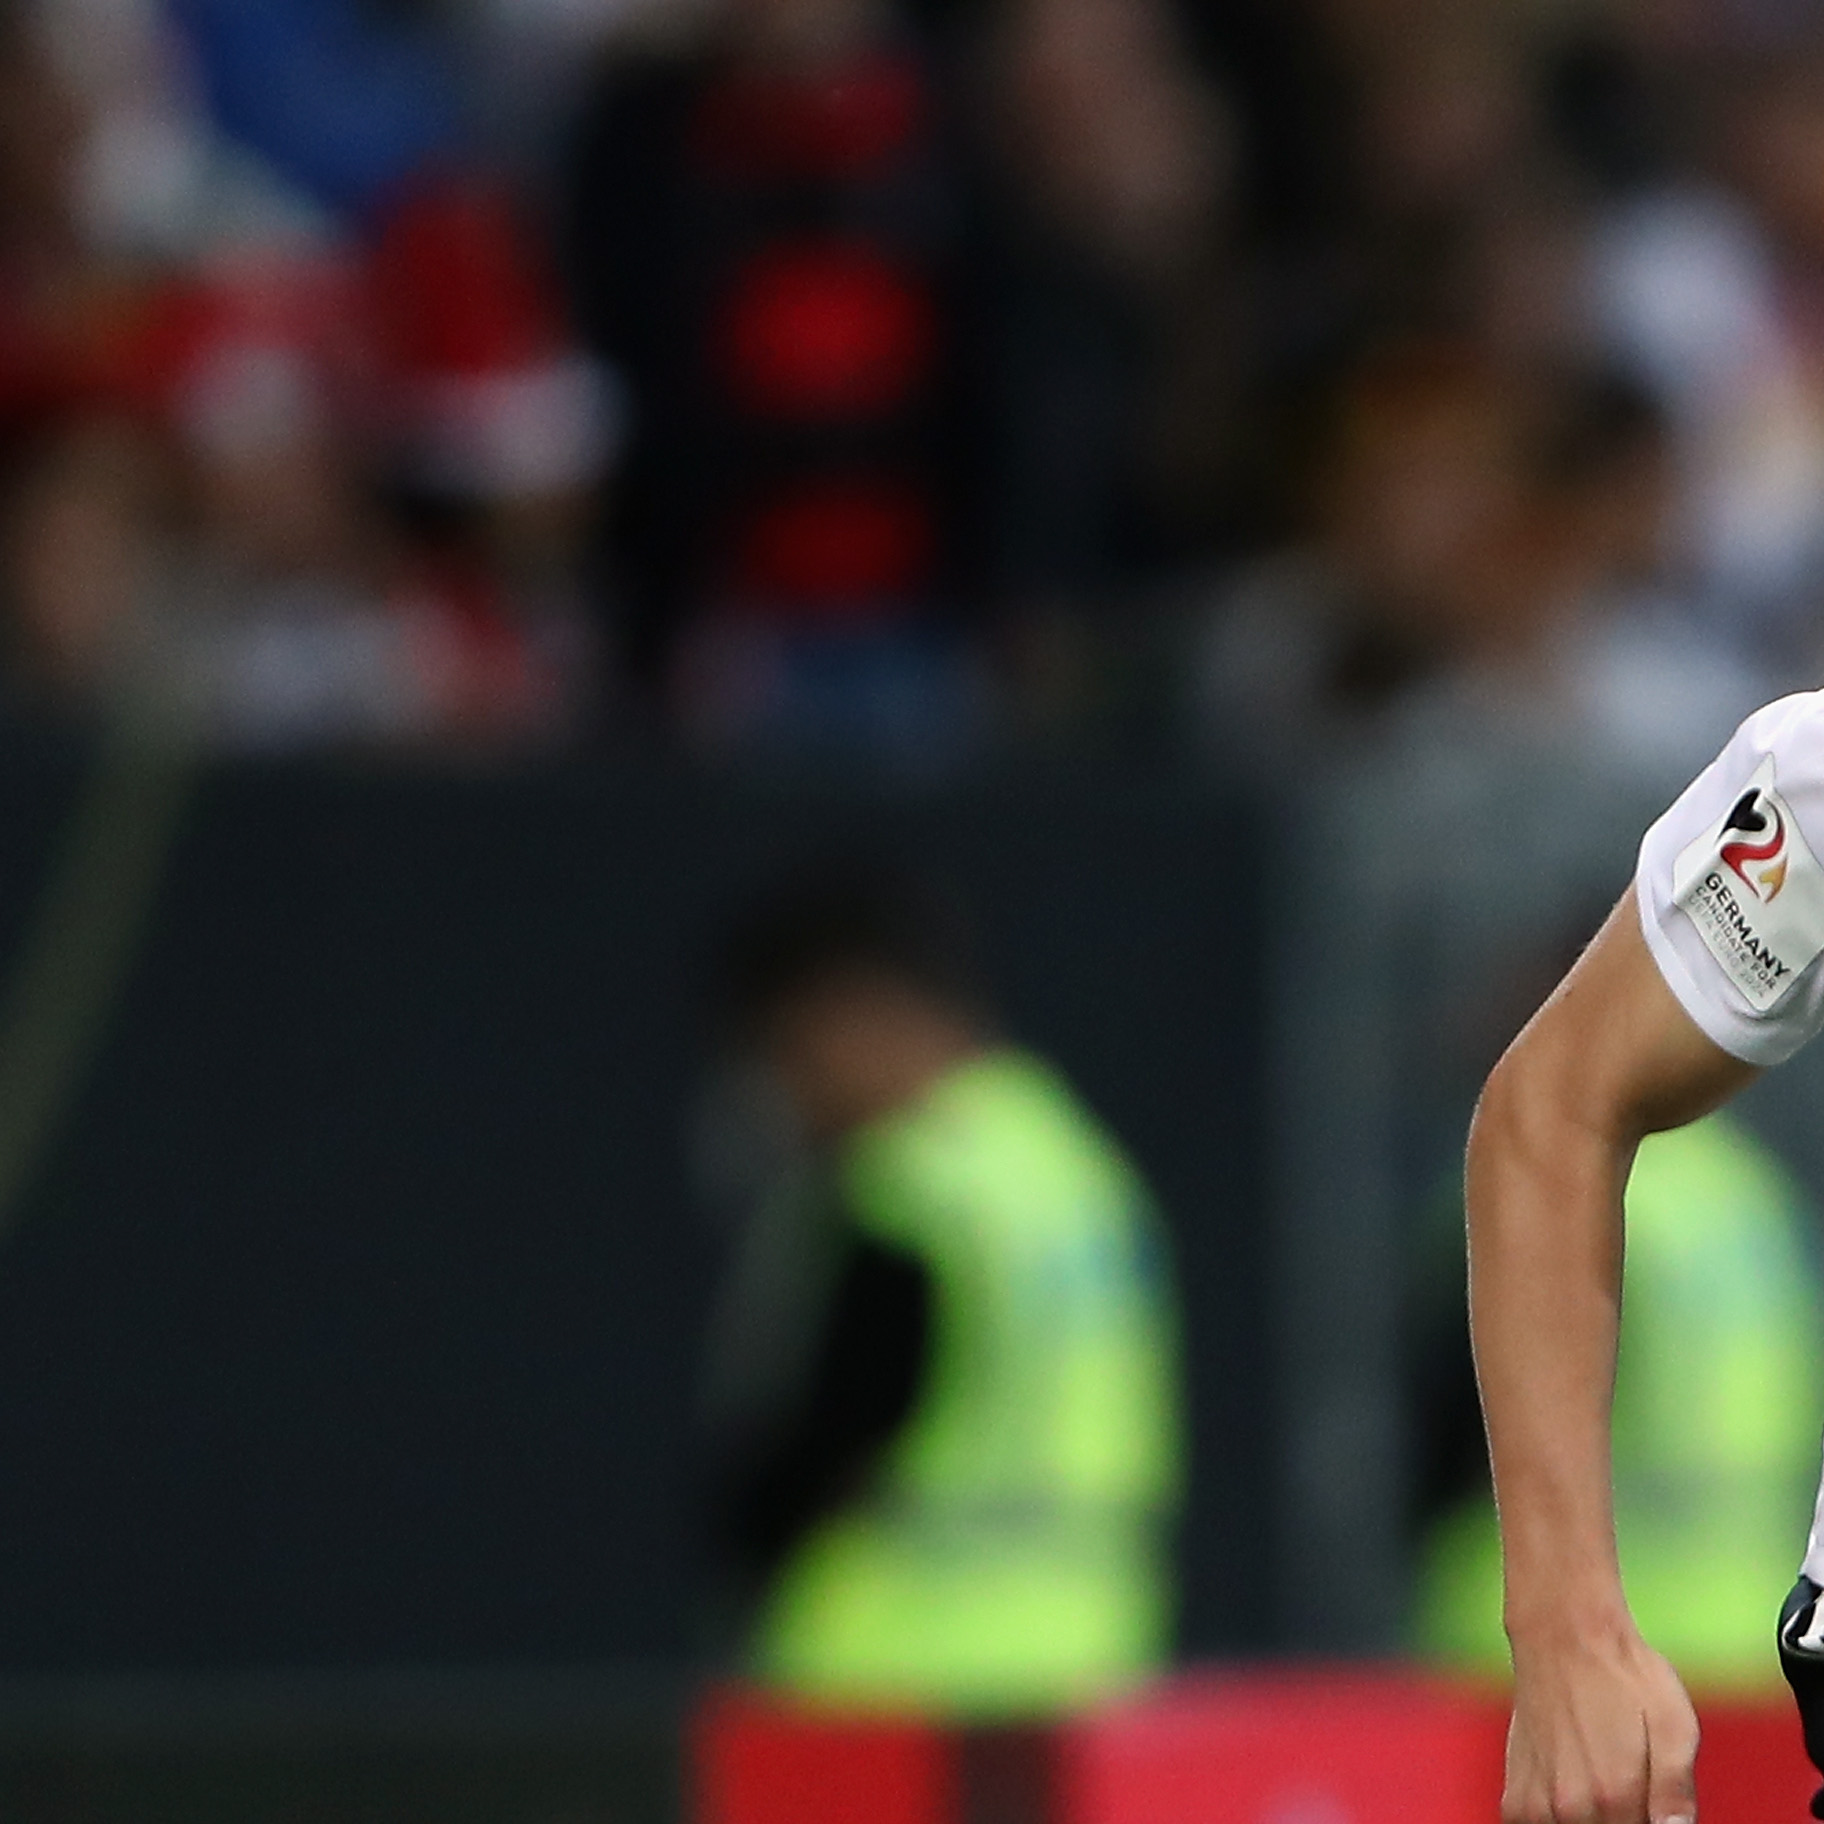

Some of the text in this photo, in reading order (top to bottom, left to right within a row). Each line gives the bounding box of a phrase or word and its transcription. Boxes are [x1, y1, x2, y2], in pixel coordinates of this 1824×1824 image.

[1695, 886, 1777, 989] CANDIDATE FOR
[1705, 871, 1790, 977] GERMANY
